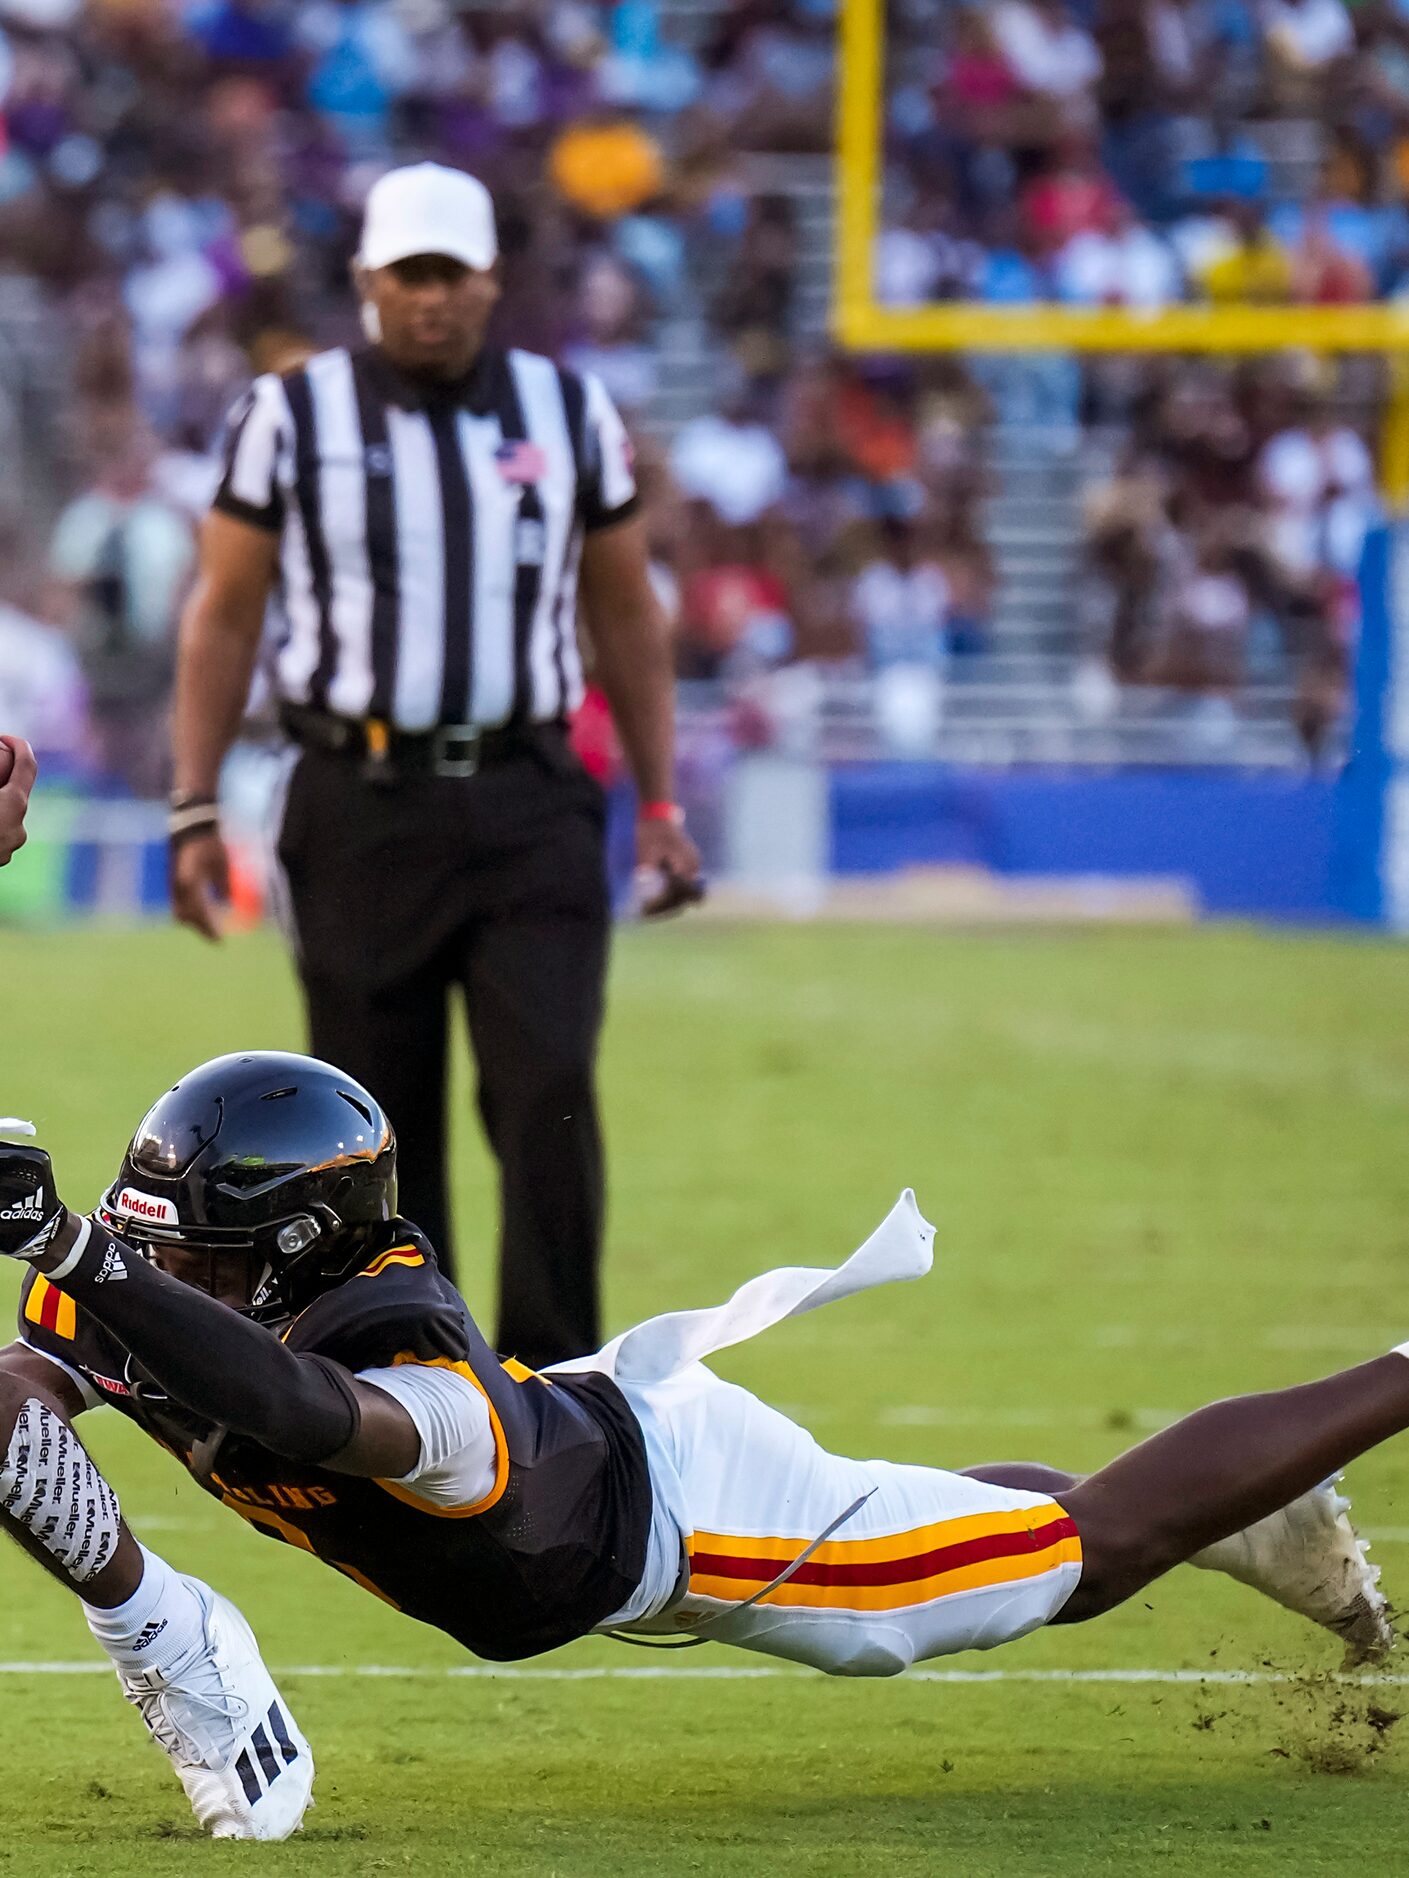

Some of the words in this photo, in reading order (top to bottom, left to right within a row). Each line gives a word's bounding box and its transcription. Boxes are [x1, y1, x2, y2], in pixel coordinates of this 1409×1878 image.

[0, 1207, 44, 1222] adidas
[121, 1192, 167, 1220] Riddell
[94, 1242, 116, 1284] adidas
[132, 1618, 168, 1651] adidas
